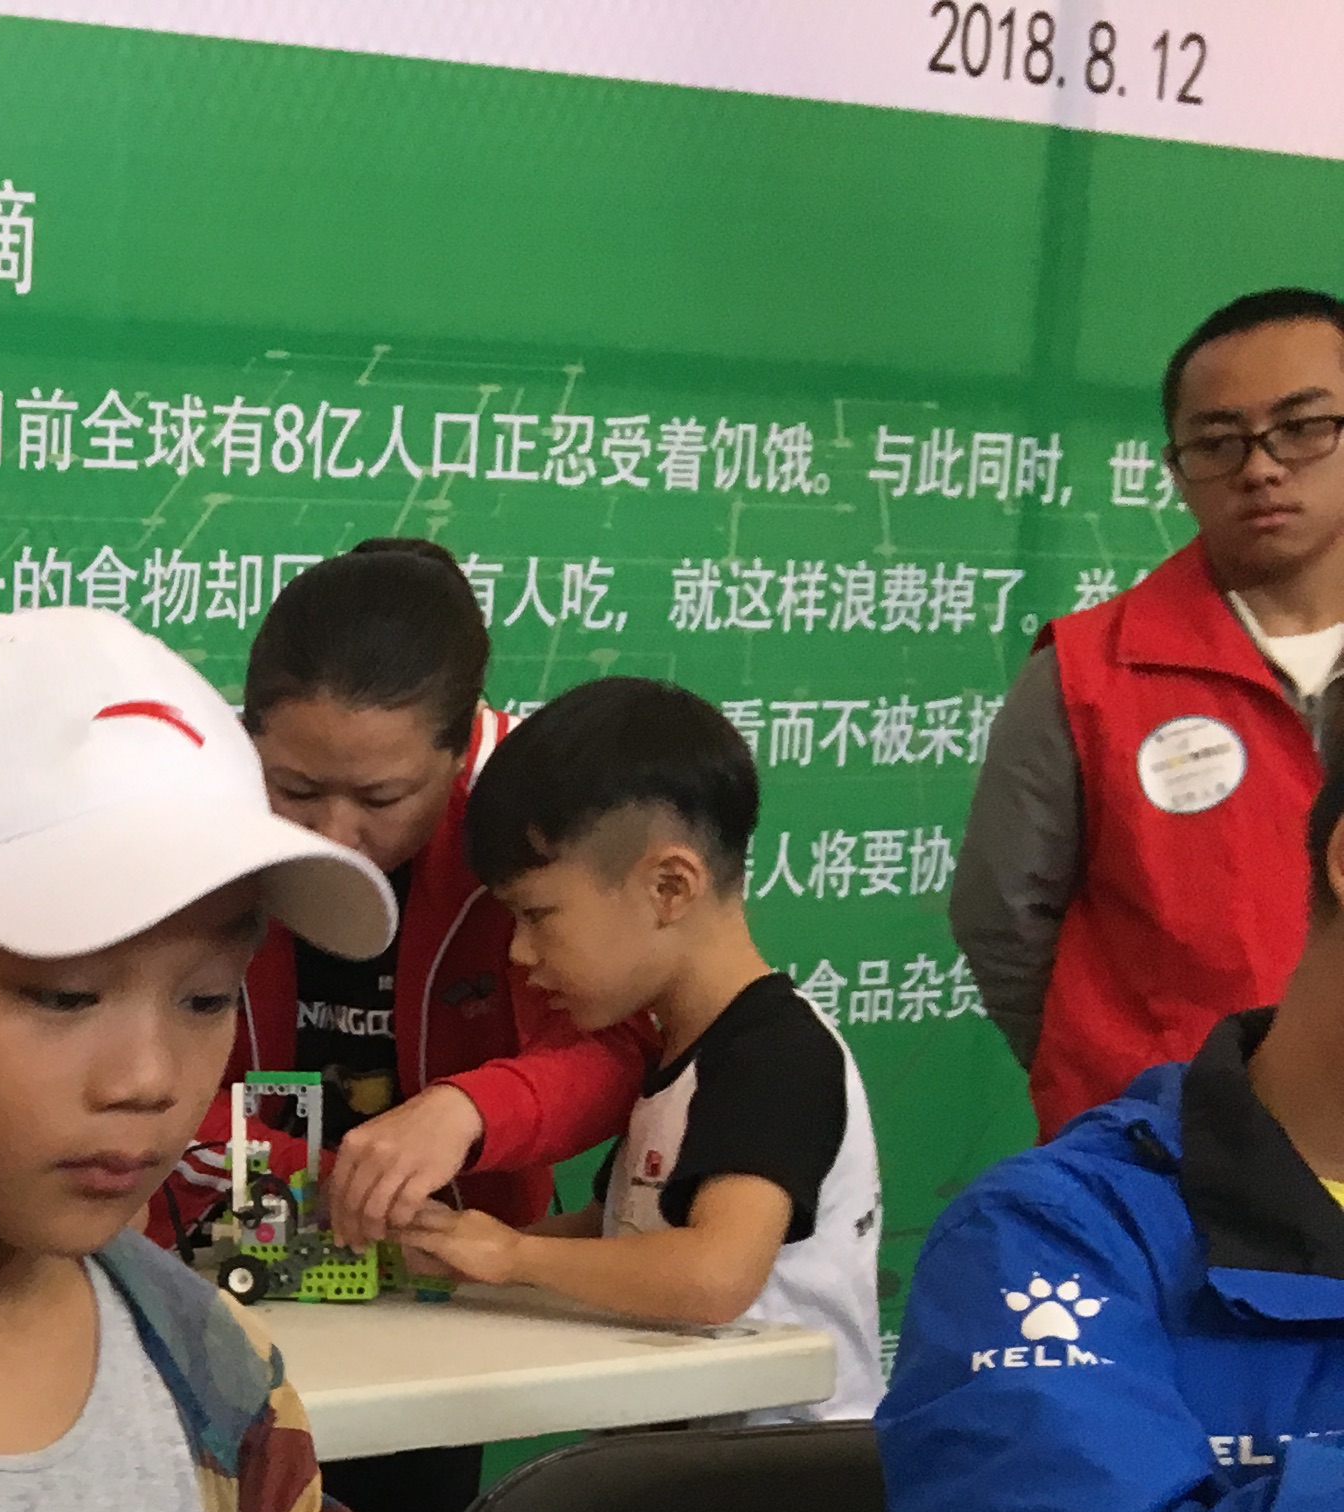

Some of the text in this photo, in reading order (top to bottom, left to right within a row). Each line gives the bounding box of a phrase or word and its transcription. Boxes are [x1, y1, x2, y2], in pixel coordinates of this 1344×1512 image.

[744, 826, 957, 899] 人将要协
[971, 1345, 1115, 1372] KELM
